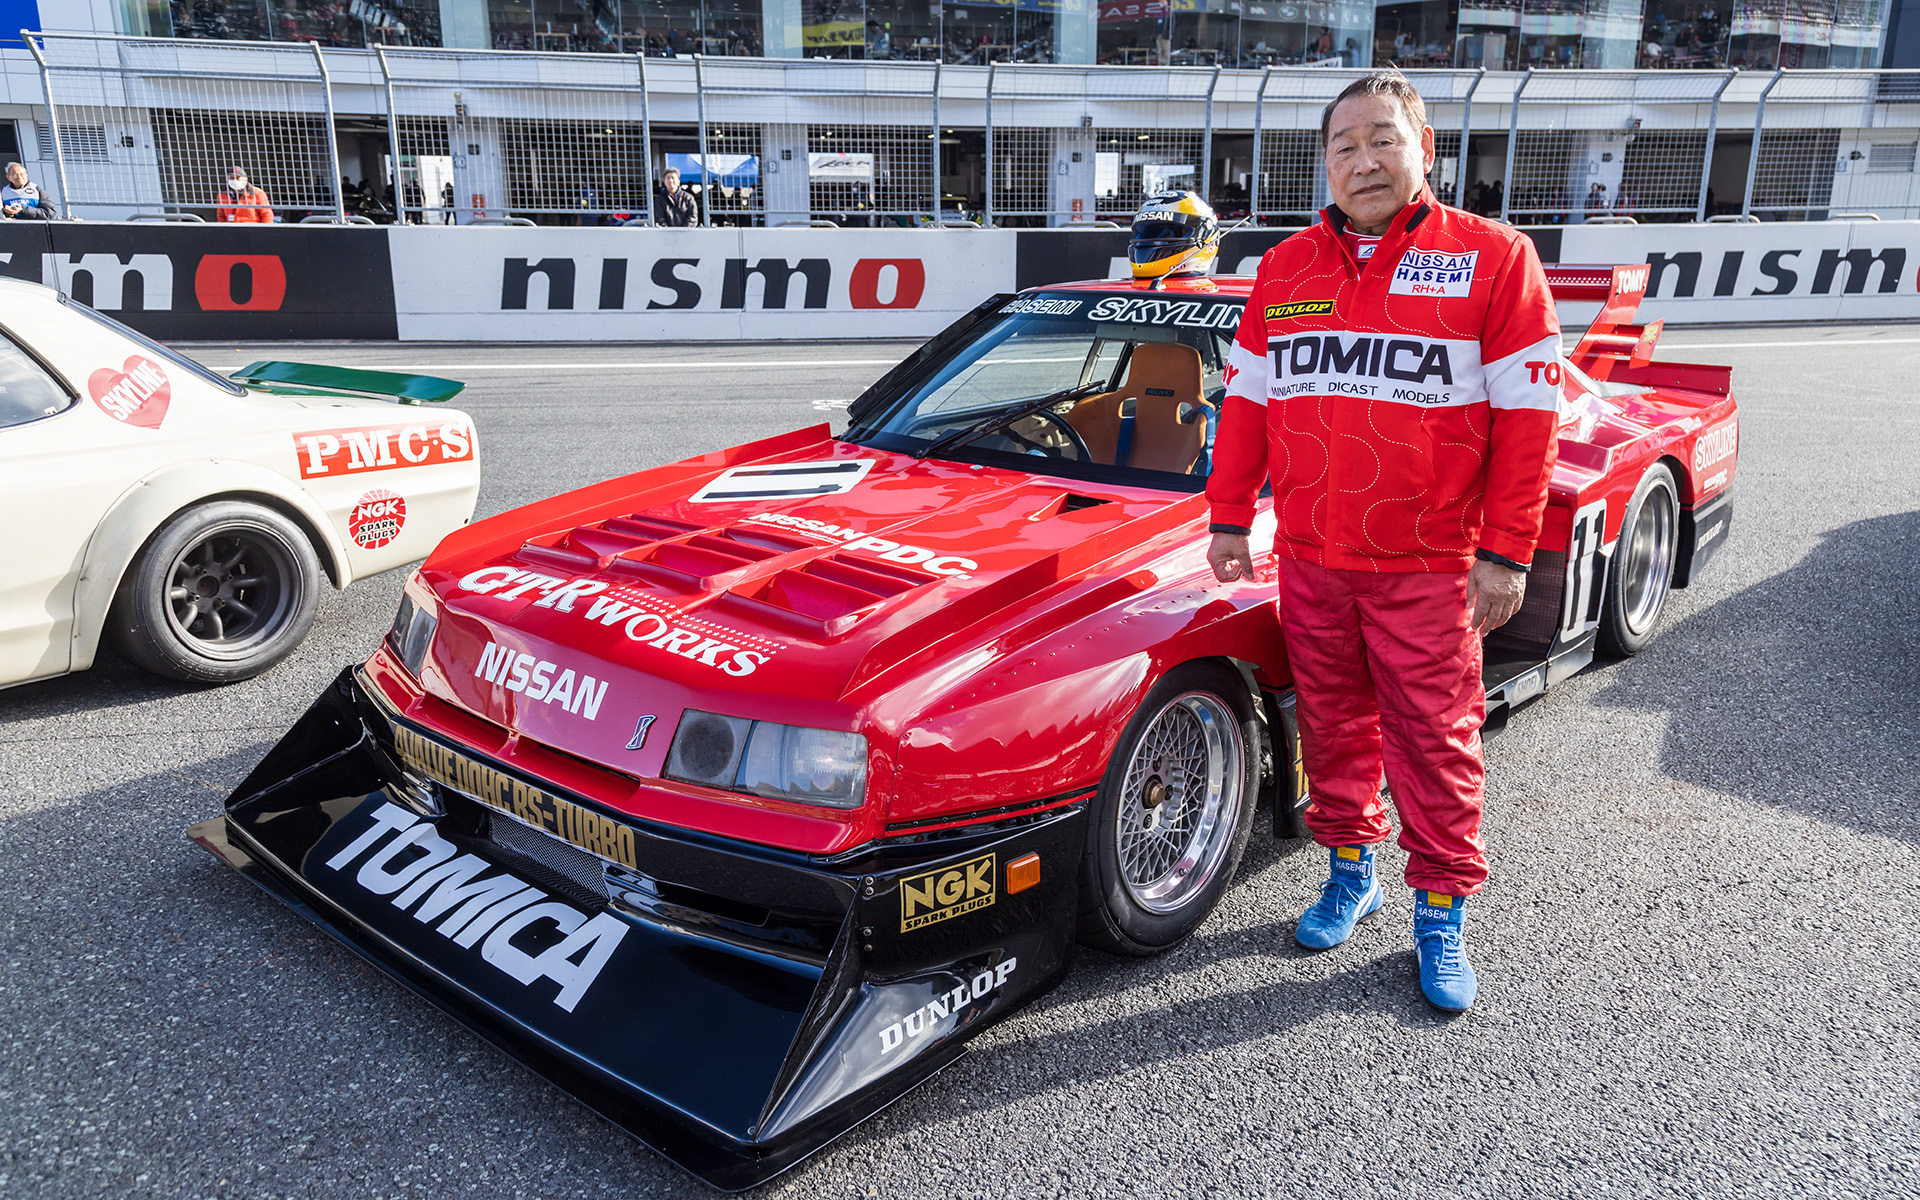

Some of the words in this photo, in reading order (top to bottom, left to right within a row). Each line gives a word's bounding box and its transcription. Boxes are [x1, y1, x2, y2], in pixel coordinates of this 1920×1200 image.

[1134, 211, 1174, 222] NISSAN
[1397, 267, 1471, 284] HASEMI
[1403, 251, 1472, 269] NISSAN
[1618, 269, 1645, 294] TOMY
[1640, 248, 1920, 298] nism
[0, 253, 287, 311] mo
[501, 258, 925, 310] nismo
[1411, 284, 1446, 295] RH+A
[1087, 297, 1246, 329] SKYLIN
[1266, 303, 1331, 318] DUNLOP
[1267, 336, 1453, 386] TOMICA
[100, 360, 167, 421] SKYLINE
[1328, 382, 1379, 396] DICAST
[1392, 388, 1450, 404] MODELS
[1695, 422, 1737, 472] SKYLINE
[358, 499, 399, 521] NGK
[359, 519, 397, 534] SPARK
[748, 512, 867, 541] NISSAN
[359, 528, 396, 544] PLUGS
[1566, 510, 1607, 632] 11
[584, 595, 771, 677] WORKS
[474, 641, 609, 721] NISSAN
[513, 780, 637, 869] RS-TURBO
[325, 802, 631, 1014] TOMICA
[905, 858, 992, 918] NGK
[905, 909, 948, 931] SPARK
[951, 895, 992, 917] PLUGS
[878, 956, 1017, 1056] DUNLOP
